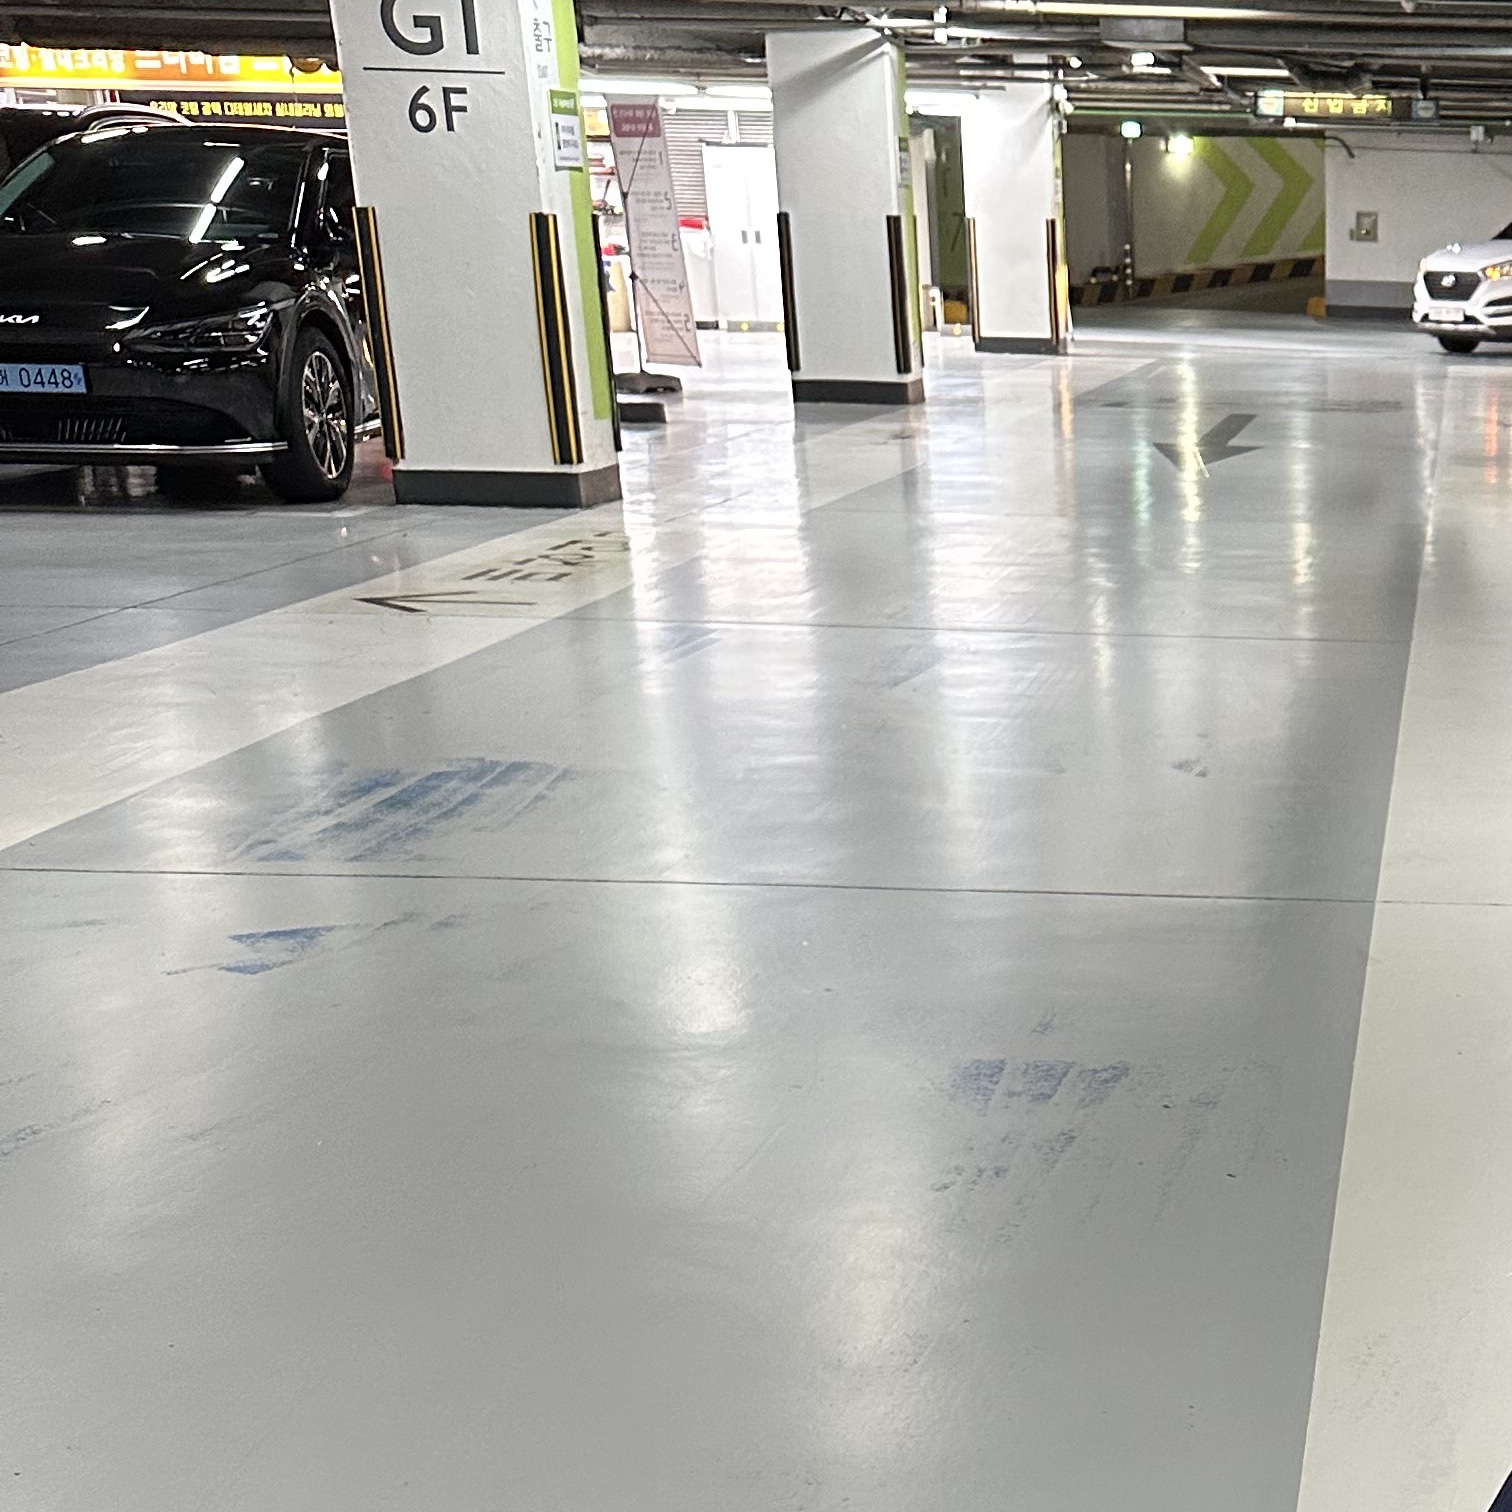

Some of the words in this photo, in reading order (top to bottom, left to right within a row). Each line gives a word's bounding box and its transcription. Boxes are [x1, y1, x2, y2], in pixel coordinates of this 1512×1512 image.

[533, 18, 552, 52] 출구
[408, 85, 467, 133] 6F
[19, 367, 73, 389] 0448
